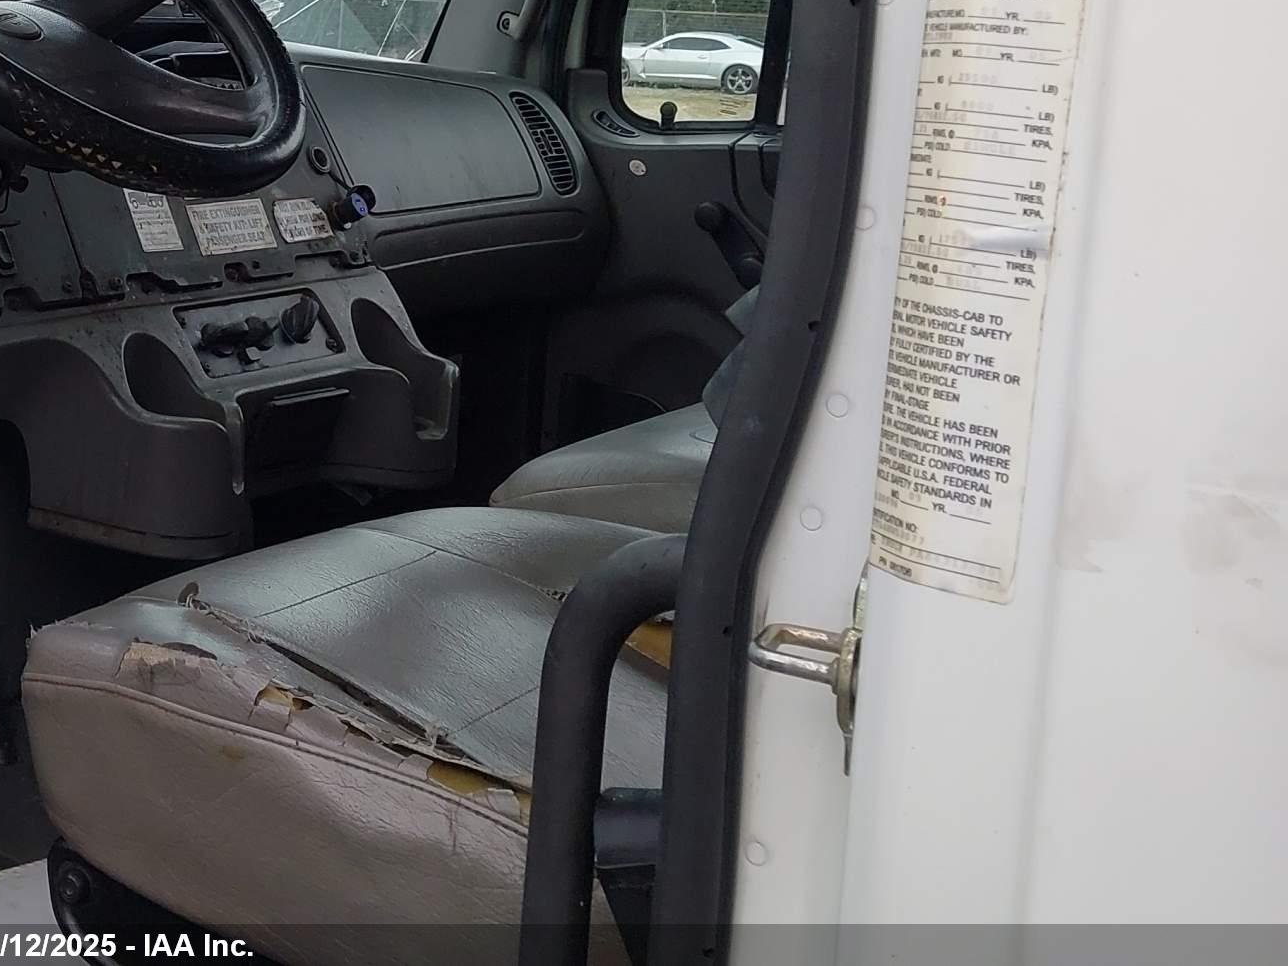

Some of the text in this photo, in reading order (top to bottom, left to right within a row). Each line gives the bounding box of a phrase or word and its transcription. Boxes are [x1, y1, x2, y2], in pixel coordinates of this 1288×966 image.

[910, 299, 921, 312] THE
[922, 302, 985, 323] CHASSIS-CAB
[989, 314, 1004, 326] TO
[897, 324, 917, 338] WHICH
[917, 330, 935, 343] HAVE
[938, 334, 965, 348] BEEN
[906, 313, 926, 327] MOTOR
[927, 318, 966, 335] VEHICLE
[970, 325, 1013, 342] SAFETY
[896, 337, 912, 351] FULLY
[913, 342, 953, 360] CERTIFIED
[955, 351, 971, 363] BY
[974, 354, 996, 368] THE
[895, 351, 918, 366] VEHICLE
[918, 358, 1001, 383] MANUFACTURER
[1003, 374, 1021, 387] OR
[919, 372, 958, 389] VEHICLE
[902, 380, 914, 393] HAS
[915, 384, 930, 397] NOT
[933, 389, 961, 403] BEEN
[896, 405, 907, 419] THE
[908, 410, 941, 428] VEHICLE
[943, 419, 966, 433] HAS
[969, 424, 999, 439] BEEN
[893, 420, 940, 442] ACCORDANCE
[941, 432, 971, 448] WITH
[974, 439, 1011, 456] PRIOR
[885, 443, 898, 457] THIS
[898, 448, 926, 467] VEHICLE
[928, 457, 991, 481] CONFORMS
[994, 471, 1010, 484] TO
[969, 452, 1011, 470] WHERE
[891, 473, 912, 490] SAFETY
[912, 481, 977, 505] STANDARDS
[979, 496, 993, 509] IN
[943, 475, 993, 495] FEDERAL
[931, 501, 948, 514] YR.
